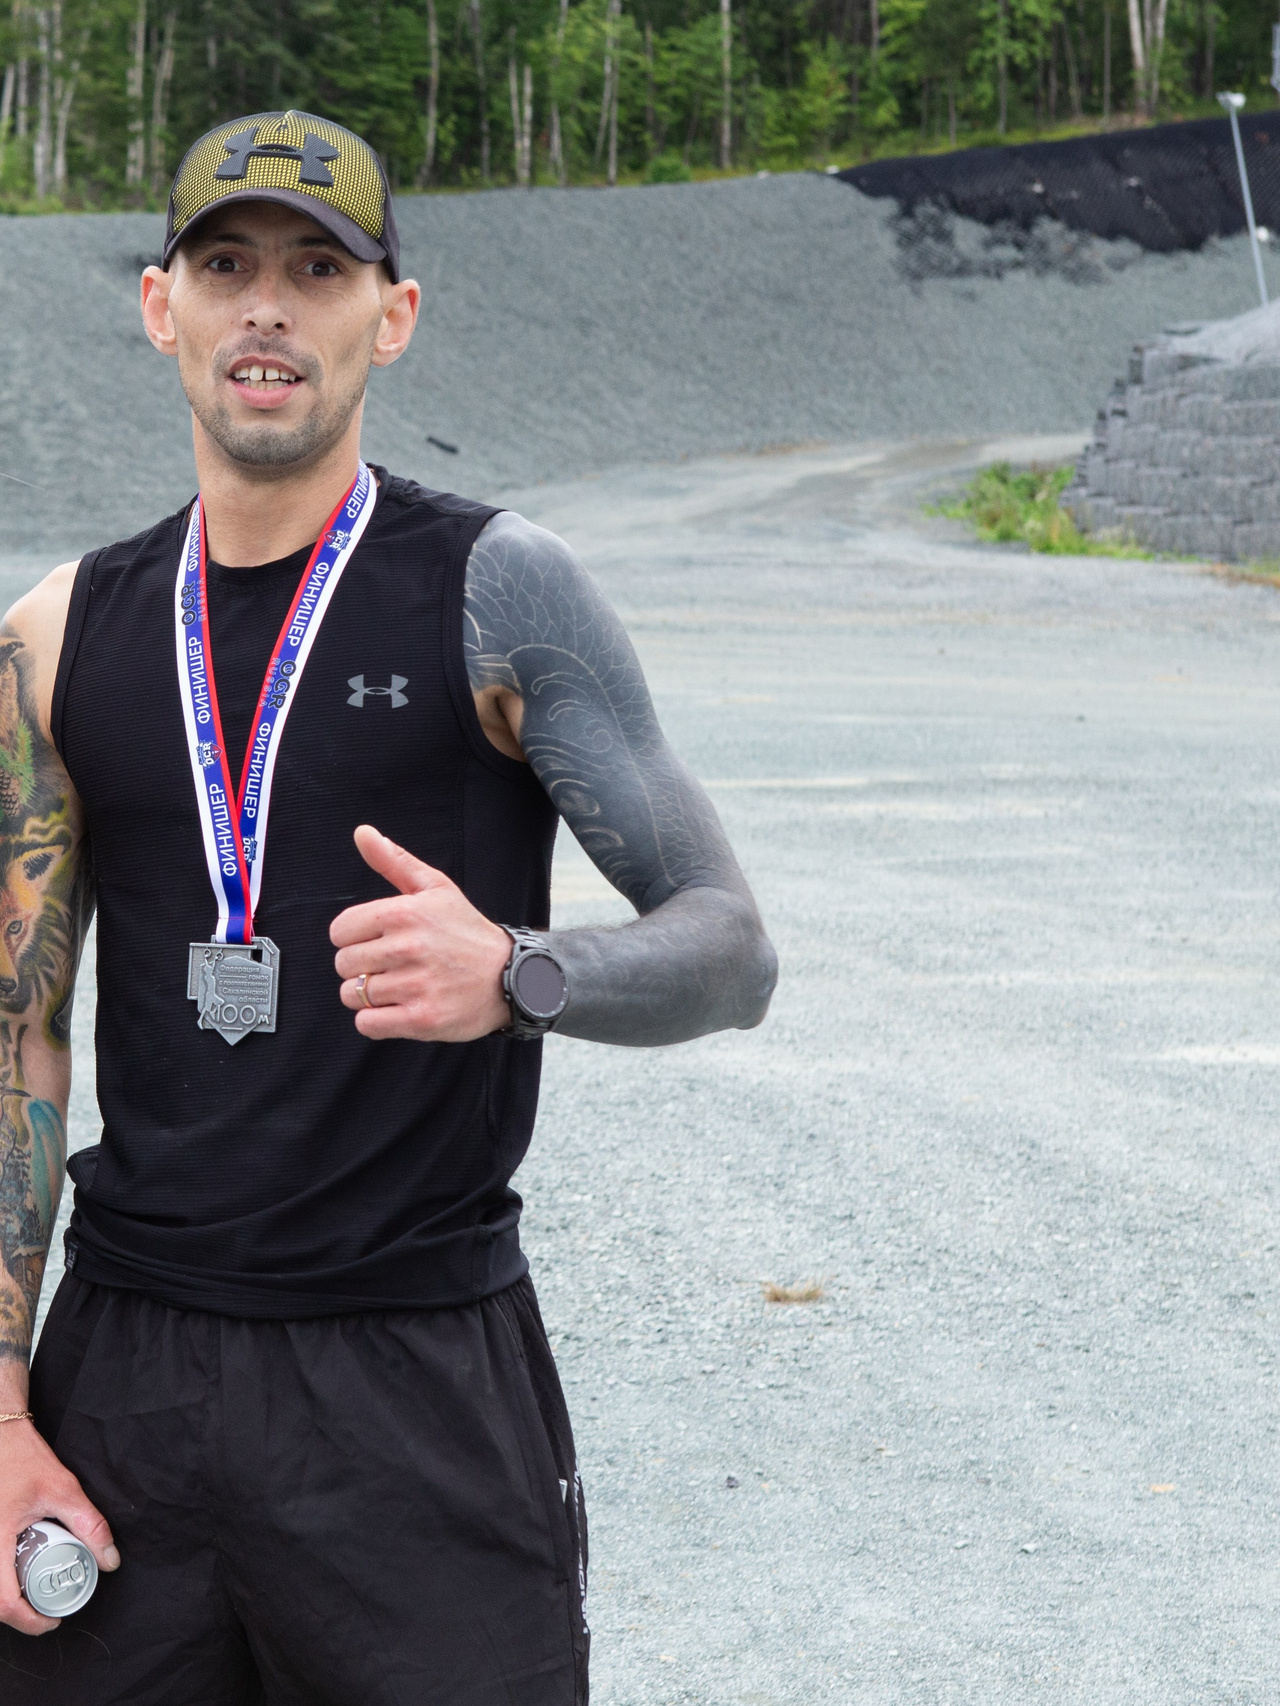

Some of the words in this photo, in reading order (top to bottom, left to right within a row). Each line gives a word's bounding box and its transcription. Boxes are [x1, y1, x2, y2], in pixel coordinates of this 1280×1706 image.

[197, 577, 207, 622] RUSSIA
[287, 562, 329, 647] ФИНИШЕР
[188, 636, 211, 724] ФИНИШЕР
[259, 657, 280, 708] RUSSIA
[244, 722, 271, 819] ФИНИШЕР
[209, 783, 238, 876] ФИНИШЕР
[219, 964, 260, 974] Федерация
[217, 1004, 256, 1025] 100
[238, 996, 268, 1004] области
